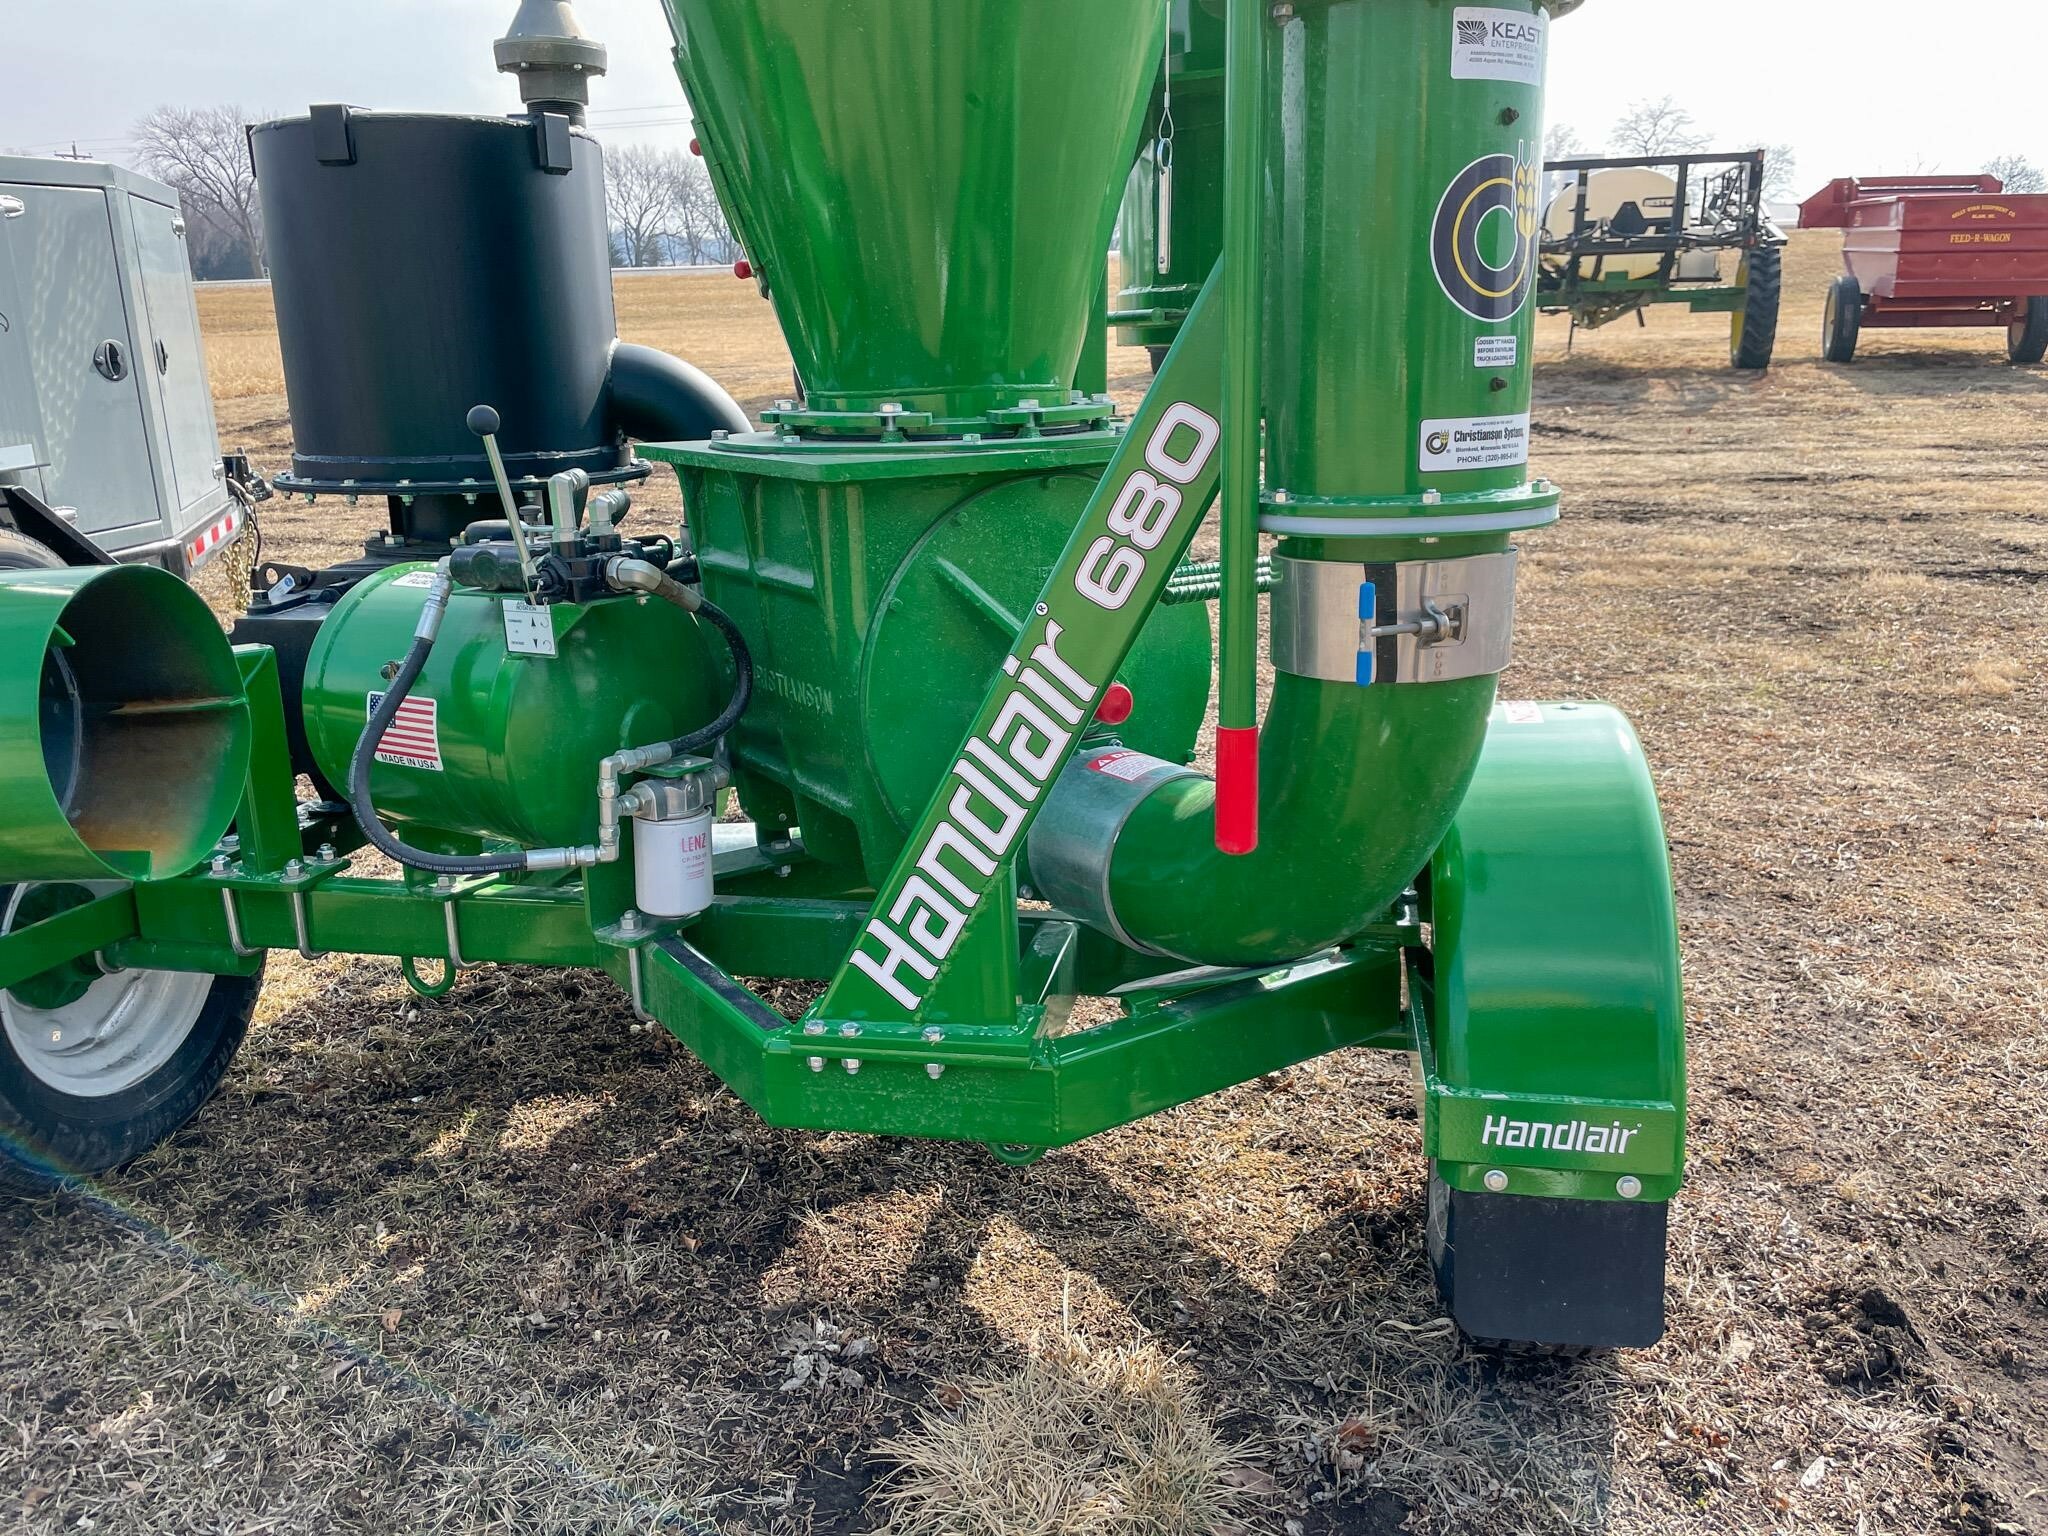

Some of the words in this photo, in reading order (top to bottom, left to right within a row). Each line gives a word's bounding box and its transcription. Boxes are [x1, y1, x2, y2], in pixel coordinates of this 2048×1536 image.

[1492, 22, 1541, 45] KEAST
[1950, 232, 2011, 243] FEED-R-WAGON
[1454, 429, 1502, 443] Christianson
[1456, 455, 1484, 464] PHONE:
[848, 618, 1098, 1012] Handlair
[1074, 401, 1221, 610] 680
[380, 753, 406, 765] MADE
[406, 758, 416, 767] IN
[416, 760, 437, 770] USA
[681, 832, 706, 853] LENZ
[1481, 1114, 1639, 1155] Handlair
